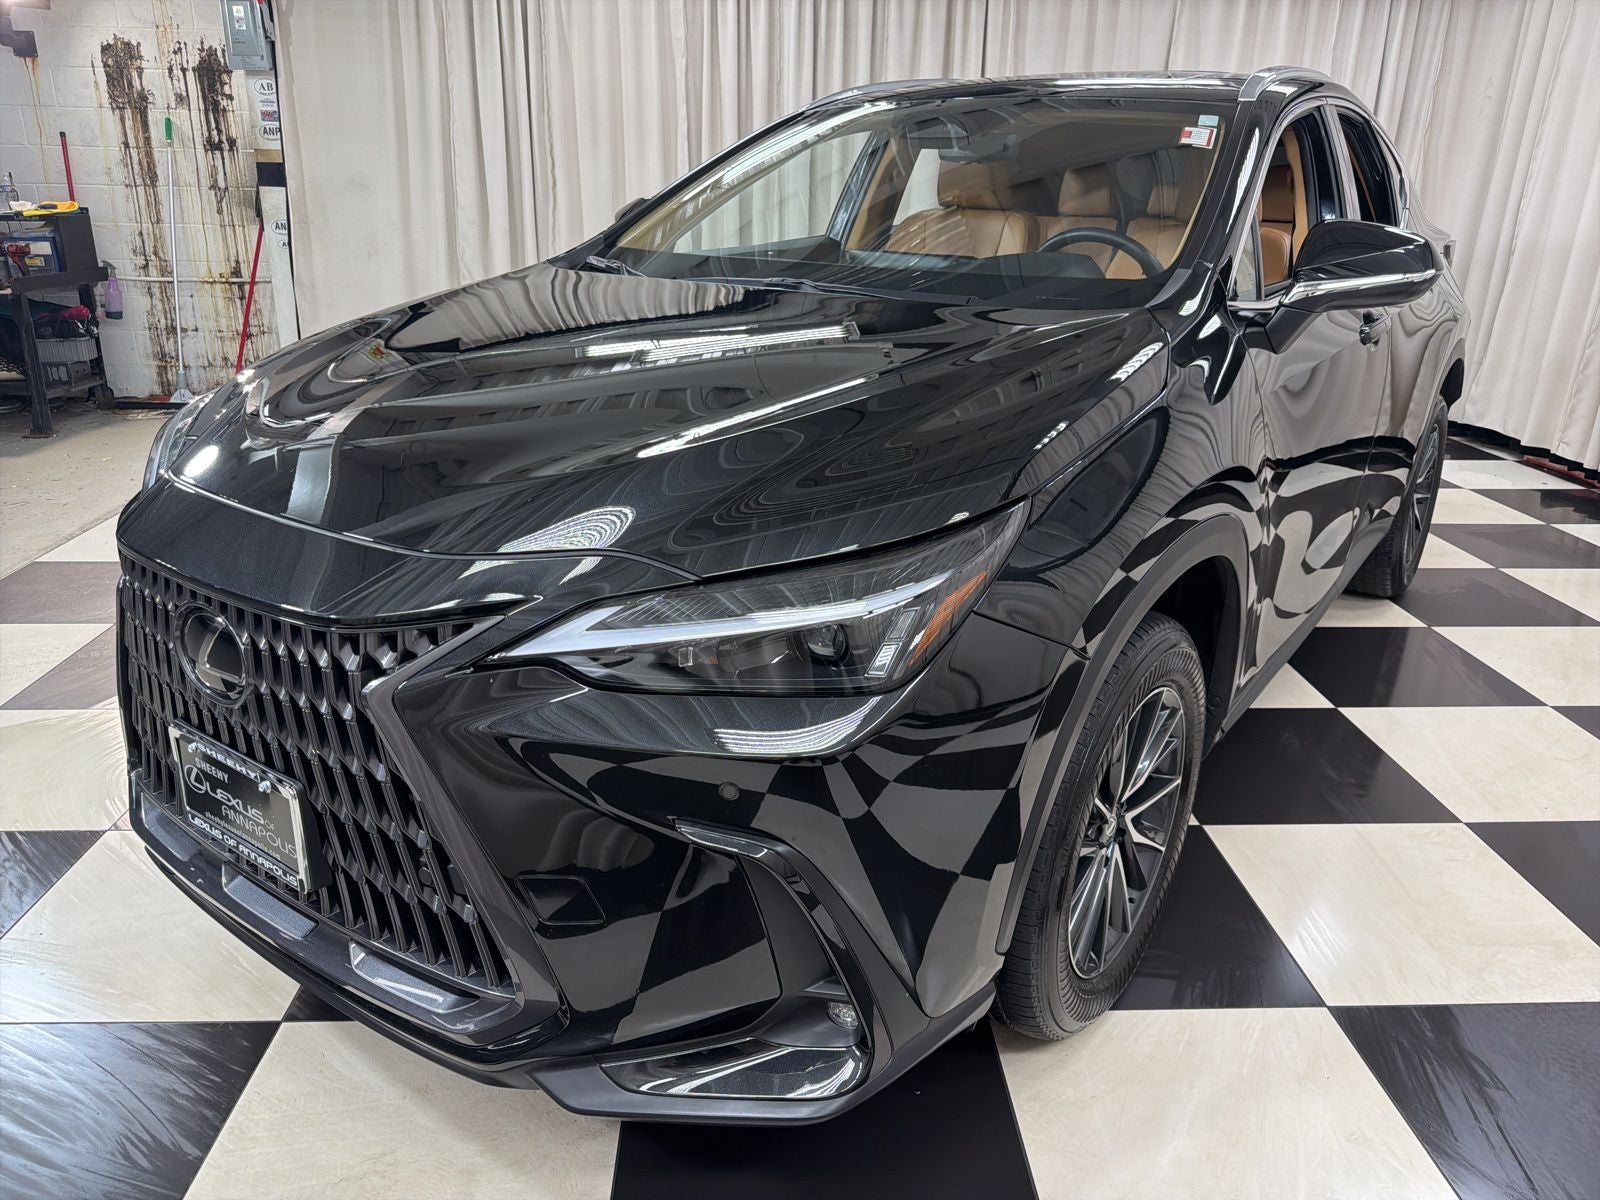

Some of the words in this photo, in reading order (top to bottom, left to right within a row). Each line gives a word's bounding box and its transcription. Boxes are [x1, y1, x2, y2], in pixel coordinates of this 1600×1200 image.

[259, 82, 274, 92] AB
[274, 222, 287, 231] AN
[195, 757, 229, 784] SHEEHY
[206, 782, 264, 824] LEXUS
[264, 819, 276, 831] OF
[188, 813, 223, 840] LEXUS
[223, 834, 238, 847] OF
[239, 844, 298, 886] ANNAPOLIS
[221, 805, 297, 859] ANNAPOLIS
